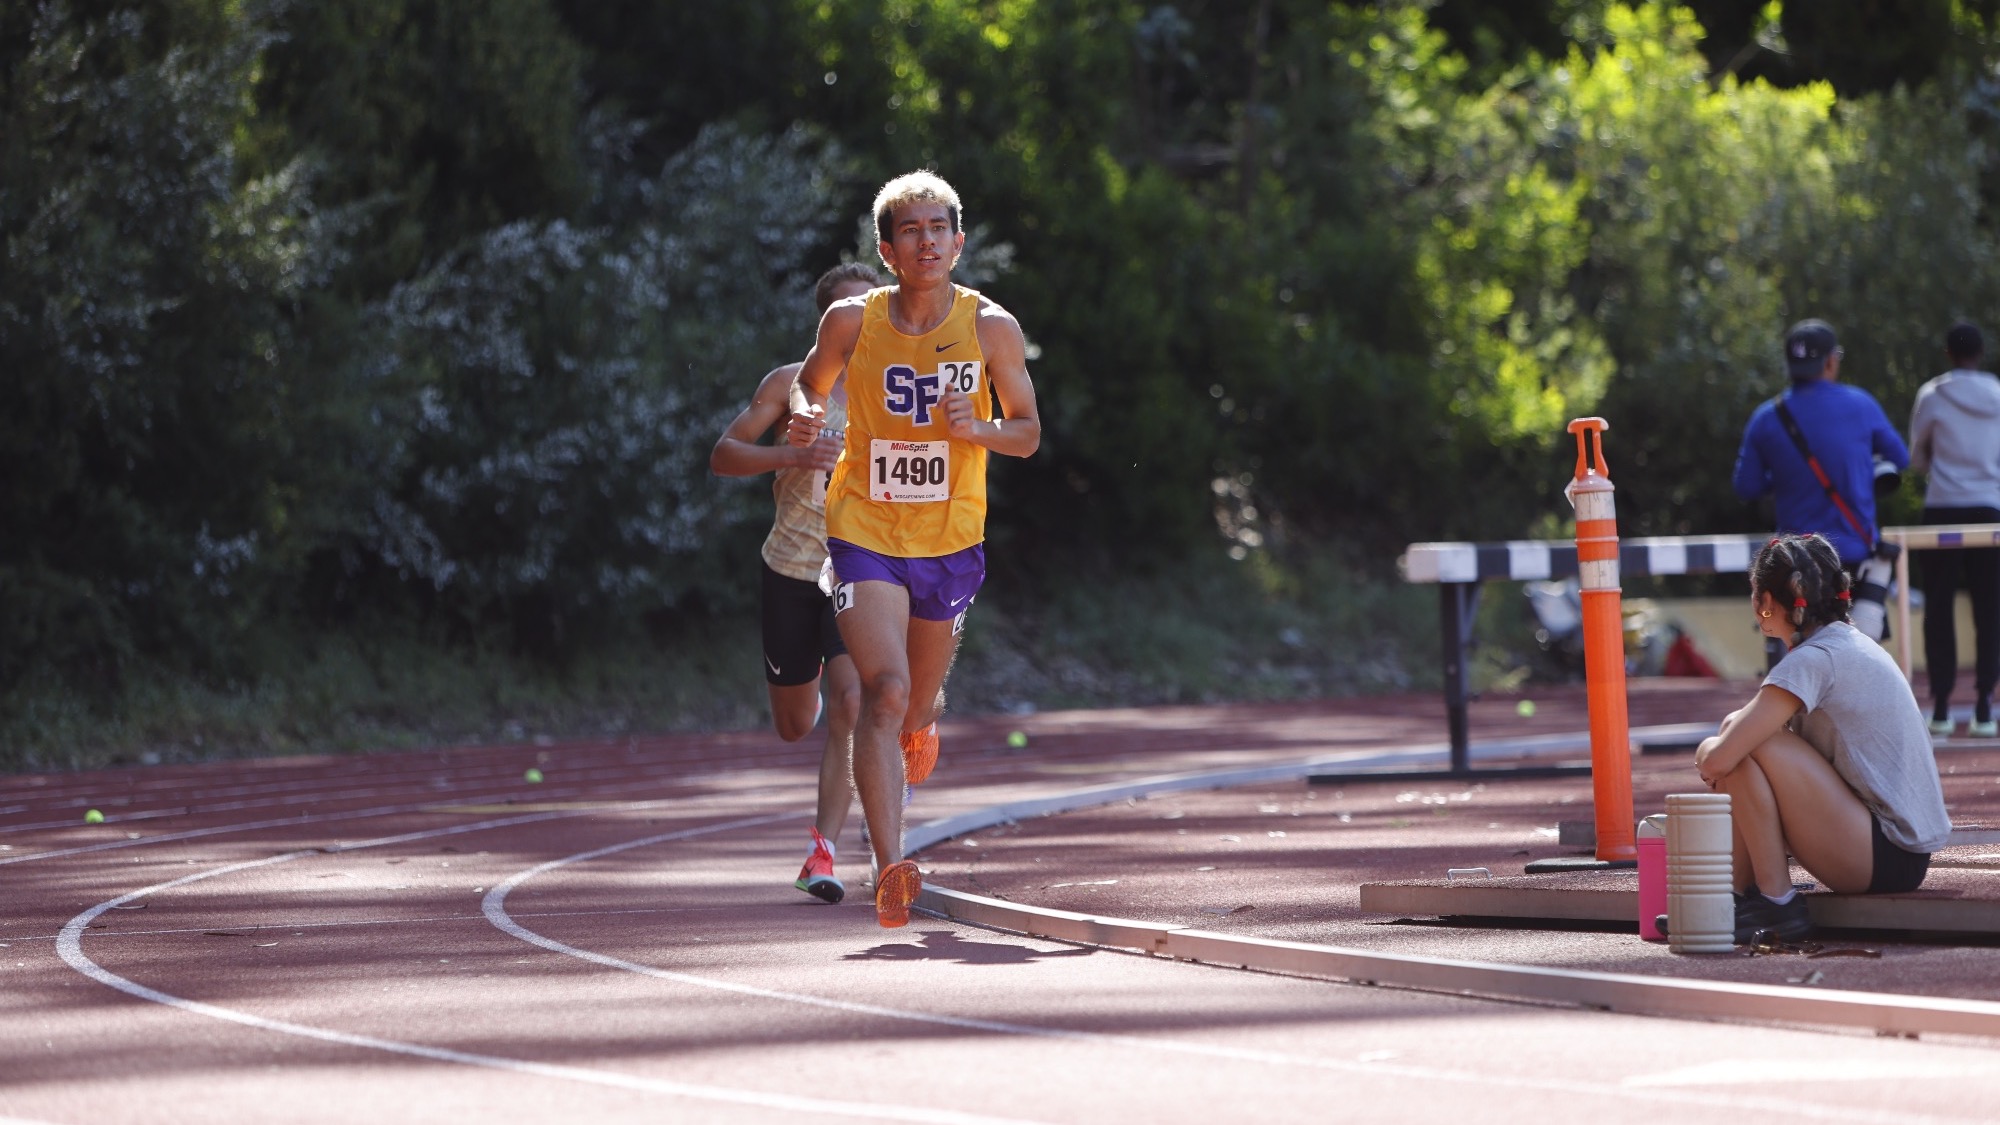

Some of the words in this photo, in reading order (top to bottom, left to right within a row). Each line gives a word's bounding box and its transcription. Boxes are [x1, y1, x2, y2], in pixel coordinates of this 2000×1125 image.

[945, 363, 974, 392] 26
[884, 364, 938, 427] SF
[890, 442, 929, 452] MileSplit
[875, 456, 945, 486] 1490
